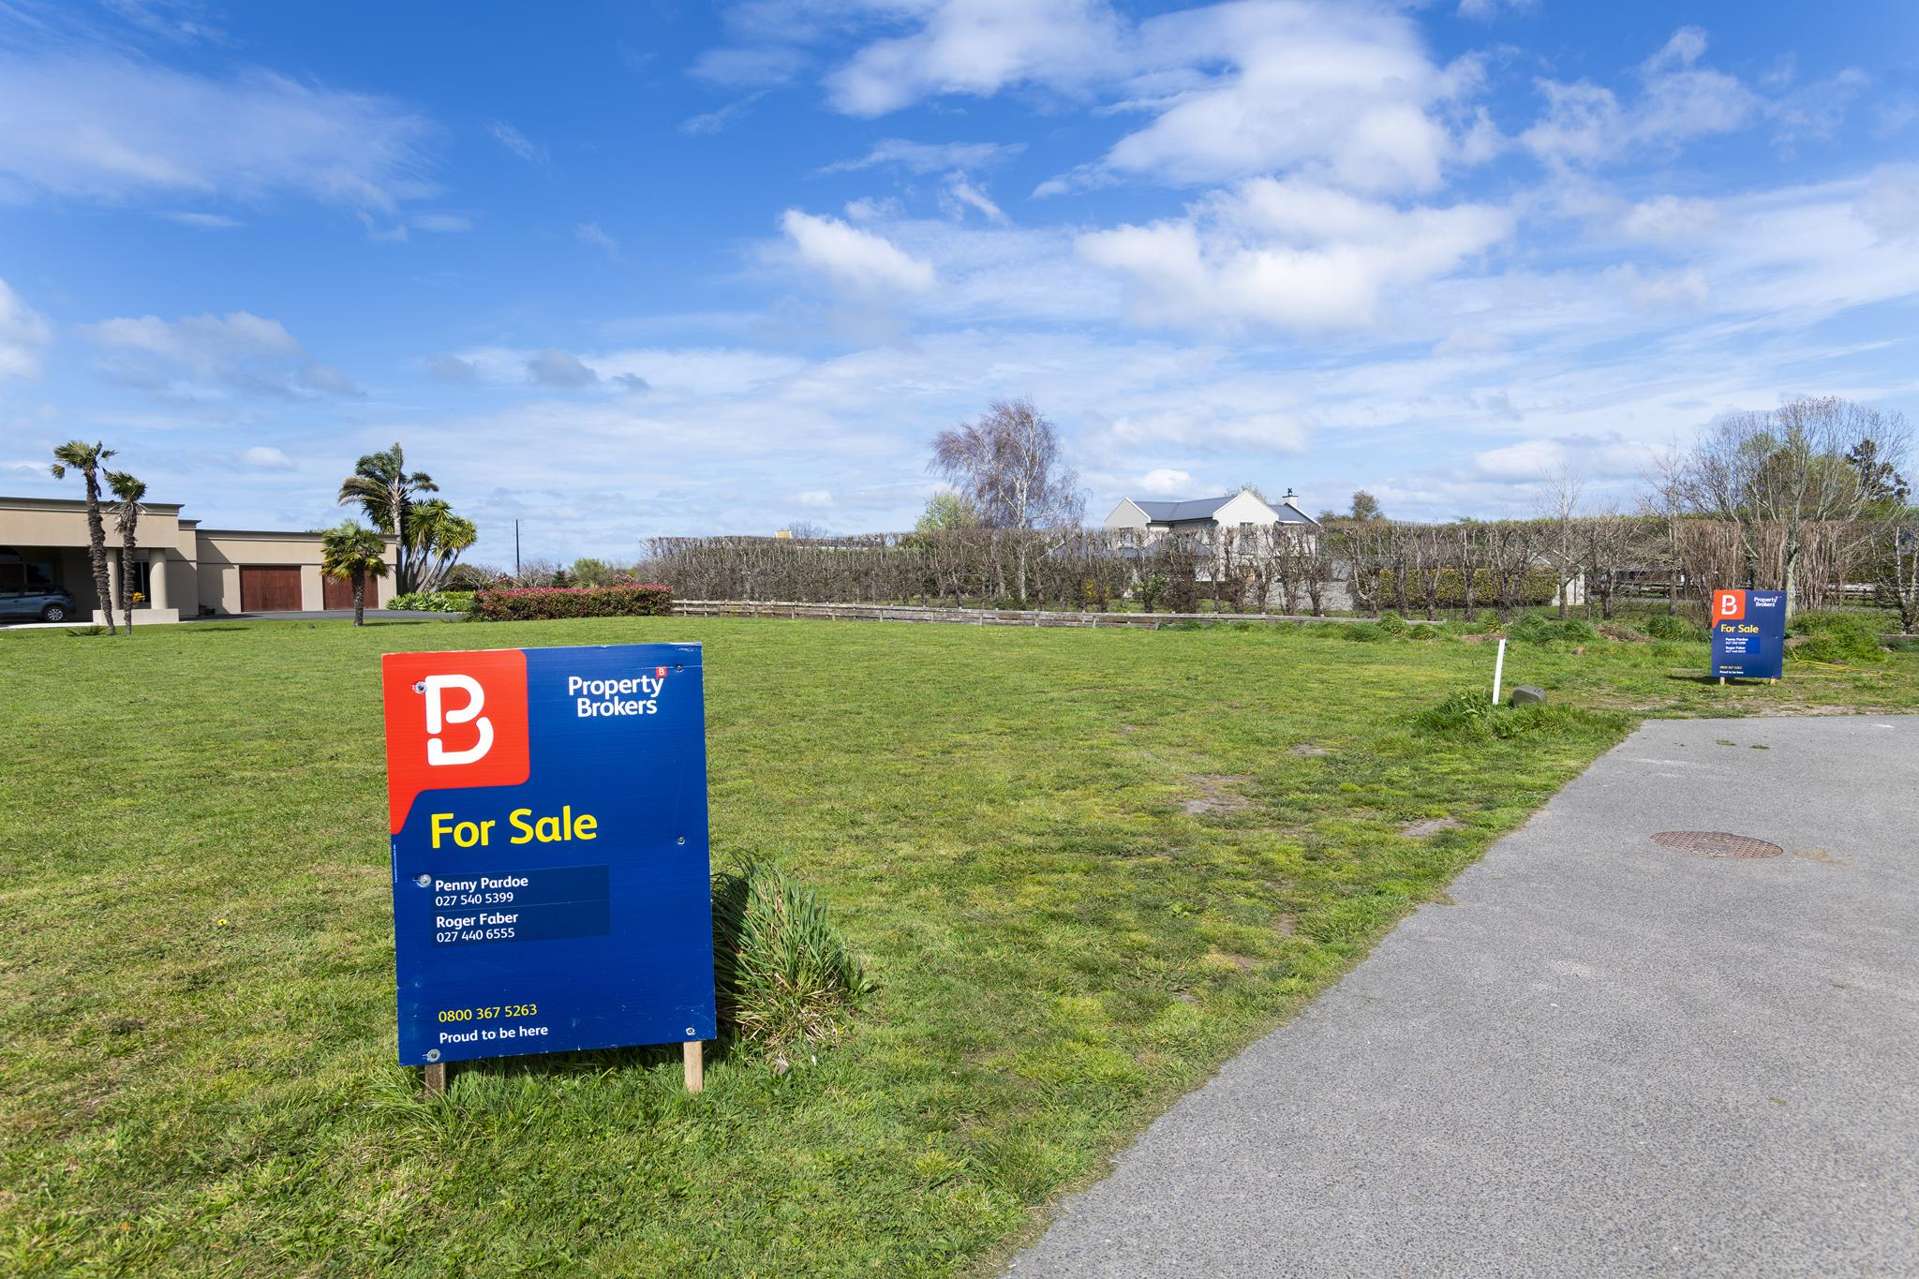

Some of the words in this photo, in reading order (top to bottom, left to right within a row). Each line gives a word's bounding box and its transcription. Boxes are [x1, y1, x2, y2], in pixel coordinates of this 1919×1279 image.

[1721, 595, 1737, 615] B
[1721, 624, 1736, 633] For
[1738, 624, 1760, 633] Sale
[568, 675, 664, 700] Property
[577, 697, 657, 718] Brokers
[425, 674, 494, 766] B
[431, 813, 496, 849] For
[509, 805, 598, 845] Sale
[435, 880, 477, 893] Penny
[481, 876, 529, 889] Pardoe
[435, 895, 457, 907] 027
[460, 894, 482, 905] 540
[485, 892, 514, 904] 5399
[436, 916, 476, 930] Roger
[479, 912, 518, 925] Faber
[436, 932, 458, 943] 027
[461, 930, 483, 941] 440
[486, 928, 515, 939] 6555
[438, 1009, 472, 1023] 0800
[476, 1007, 501, 1020] 367
[505, 1004, 538, 1018] 5263
[440, 1030, 478, 1044] Proud
[482, 1030, 496, 1040] to
[499, 1027, 516, 1038] be
[519, 1026, 549, 1037] here
